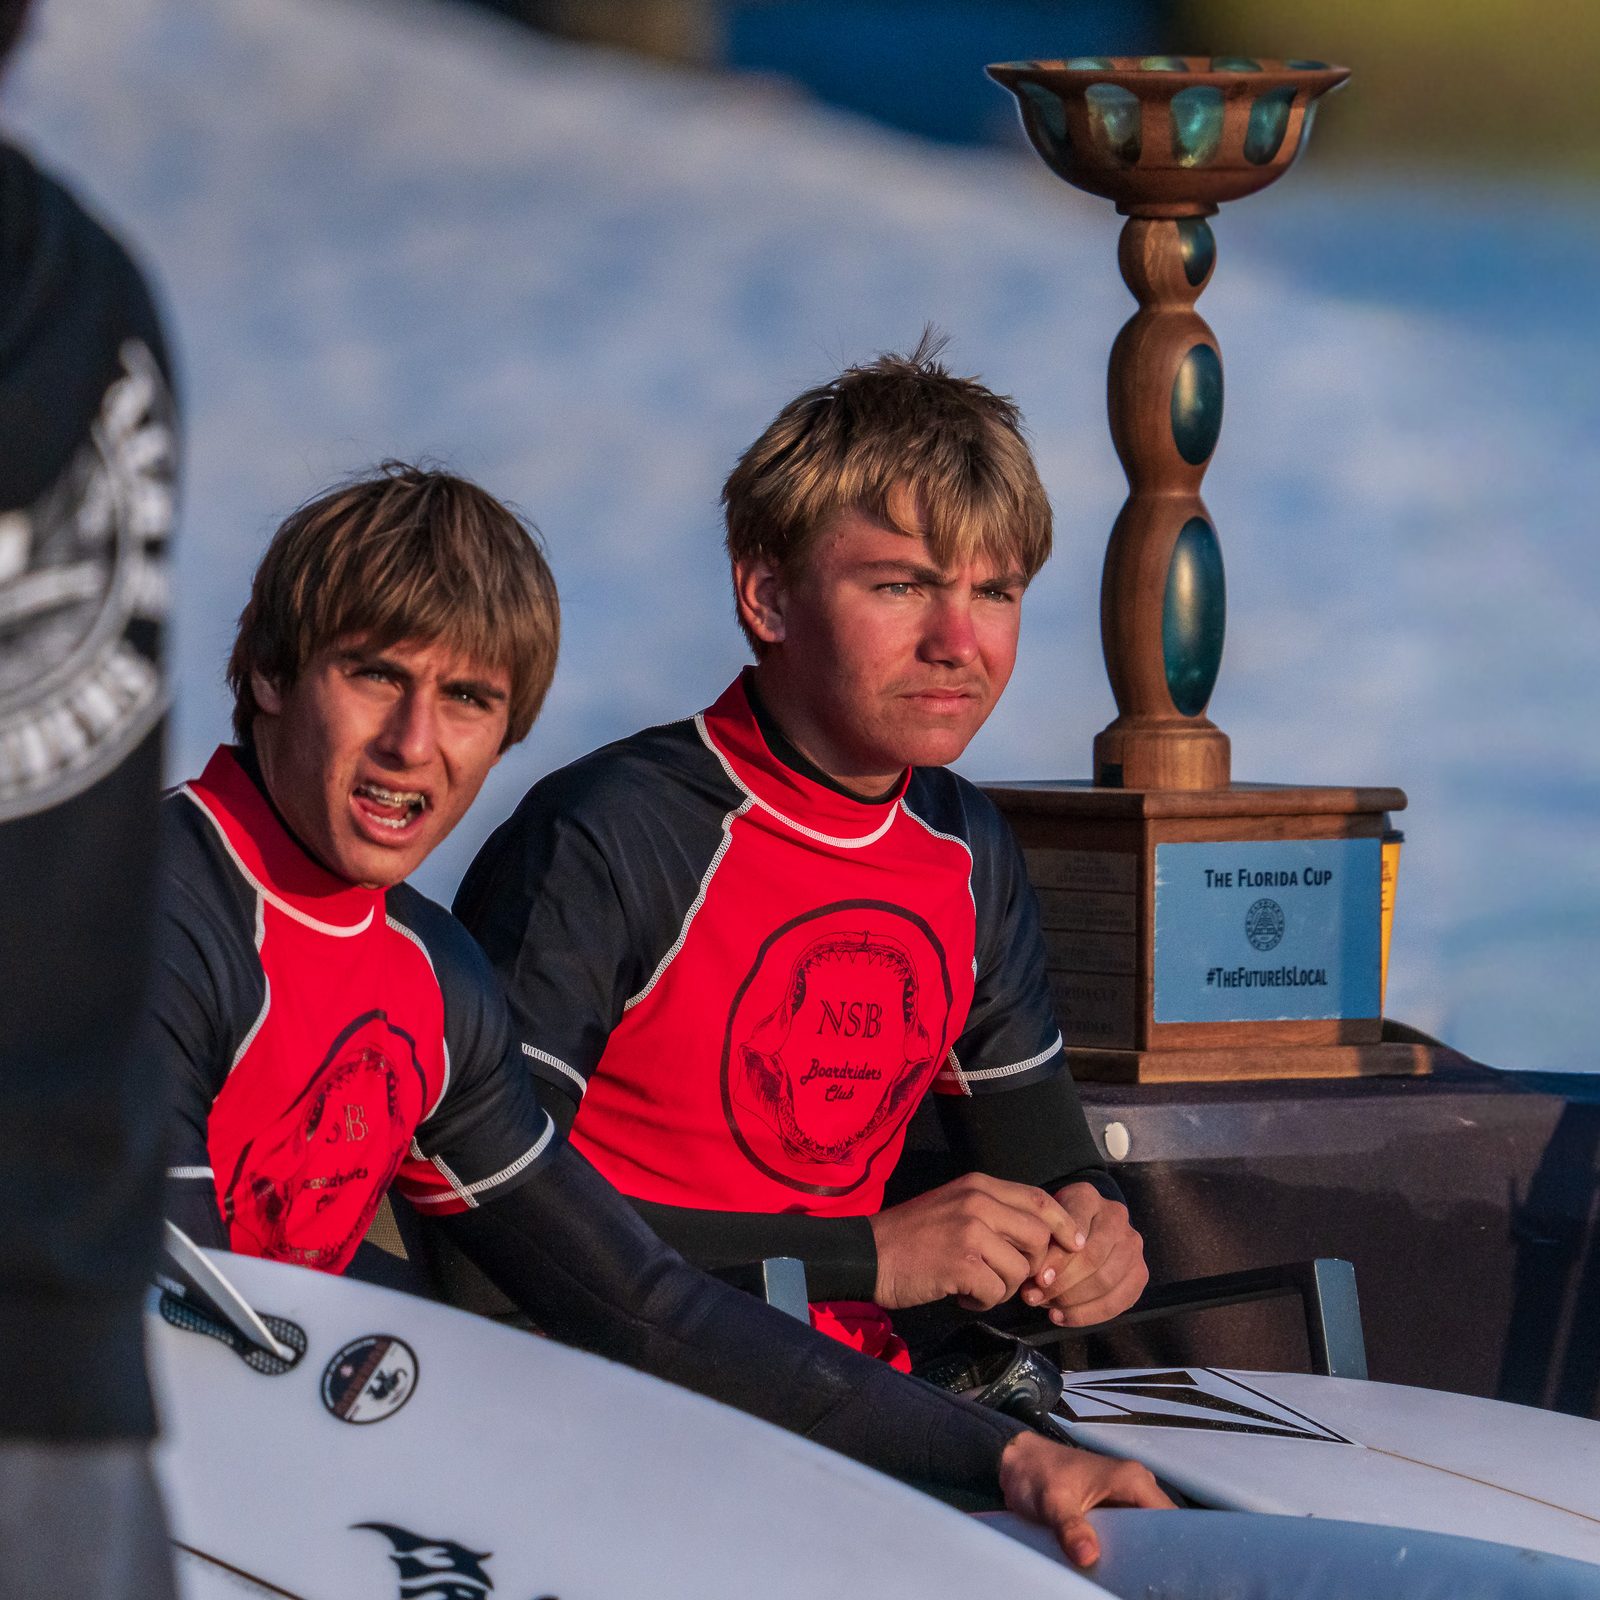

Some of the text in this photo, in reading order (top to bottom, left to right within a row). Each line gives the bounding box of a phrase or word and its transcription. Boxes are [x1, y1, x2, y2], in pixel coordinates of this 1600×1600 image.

[1238, 868, 1298, 888] FLORIDA
[1303, 867, 1333, 886] CUP
[816, 1000, 882, 1038] NSB
[800, 1058, 882, 1085] Boardriders
[825, 1084, 855, 1102] Club
